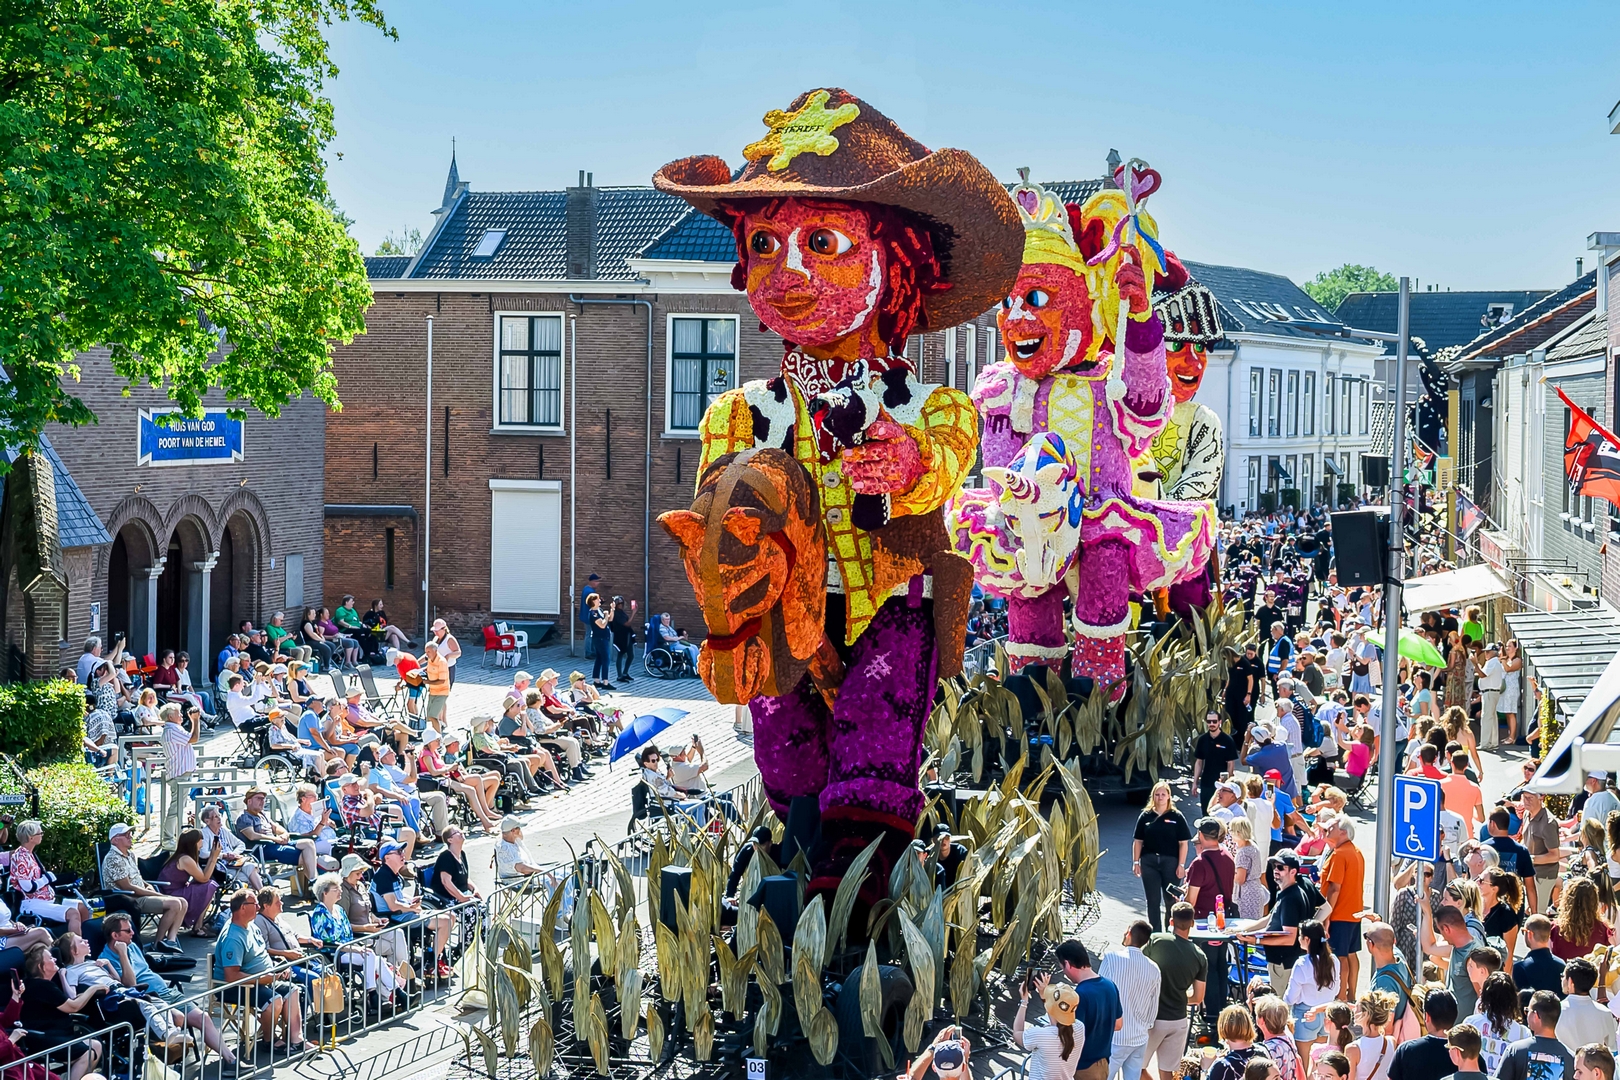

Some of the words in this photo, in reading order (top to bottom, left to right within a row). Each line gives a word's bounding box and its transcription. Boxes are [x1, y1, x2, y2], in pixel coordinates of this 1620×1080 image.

[171, 421, 186, 432] HUIS
[187, 421, 200, 432] VAN
[201, 421, 215, 432] GOD
[158, 437, 180, 449] POORT
[182, 438, 194, 448] VAN
[195, 437, 204, 447] DE
[205, 436, 226, 447] HEMEL
[1403, 784, 1427, 823] P
[749, 1061, 764, 1073] 03
